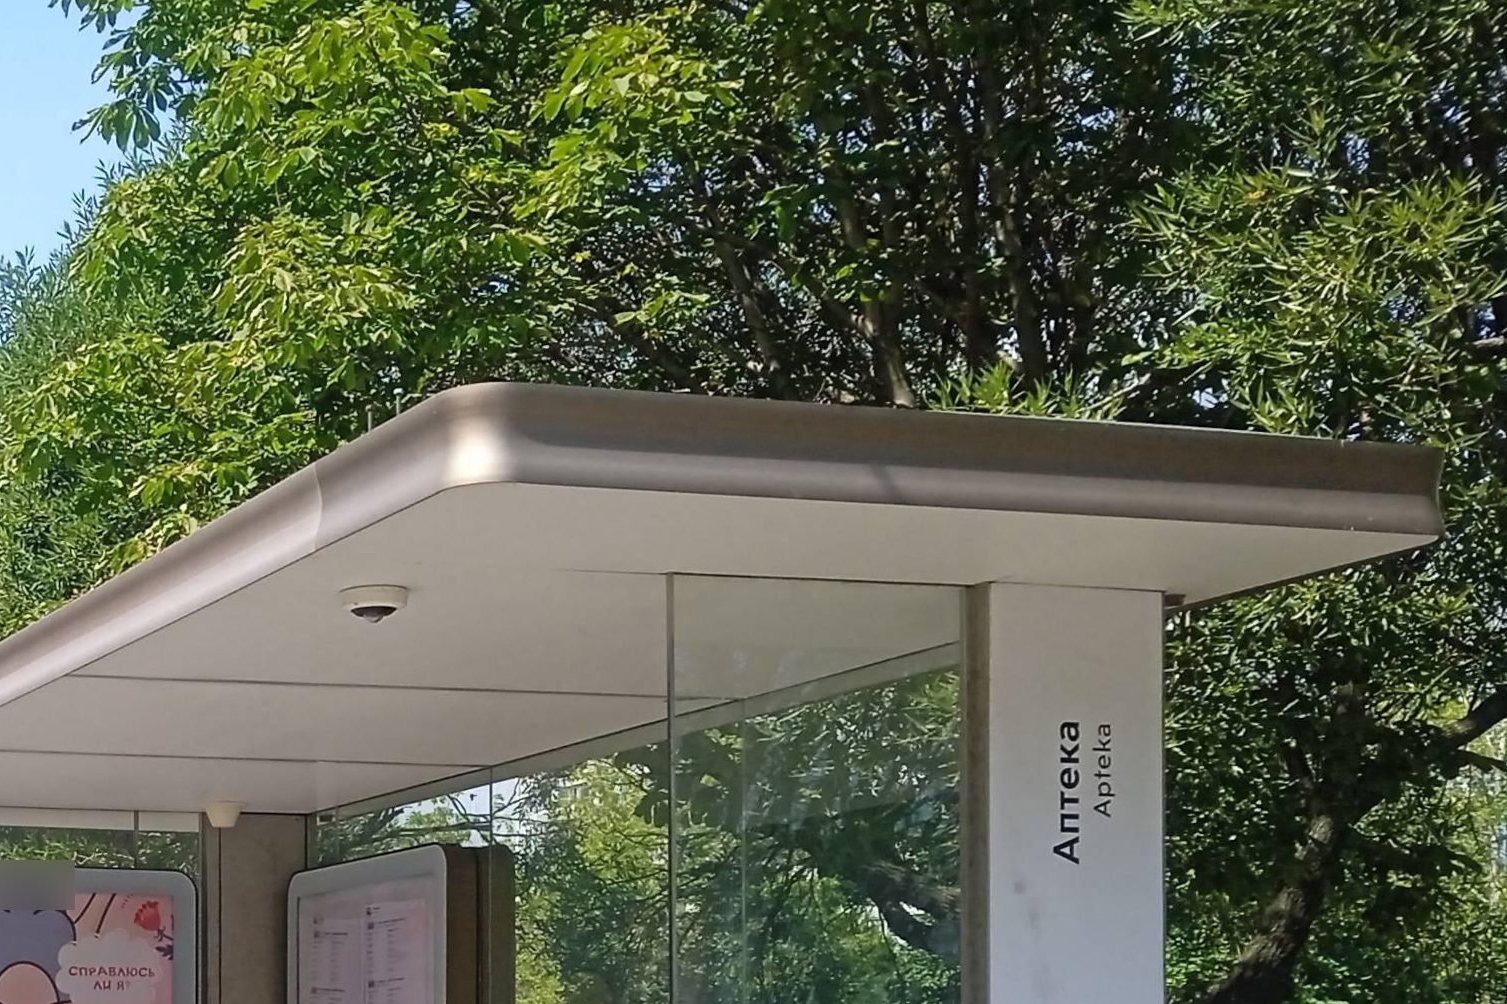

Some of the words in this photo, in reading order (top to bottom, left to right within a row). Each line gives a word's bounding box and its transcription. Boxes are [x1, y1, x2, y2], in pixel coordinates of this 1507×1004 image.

[1053, 721, 1080, 865] Аптека
[1092, 724, 1115, 818] Apteka
[68, 965, 156, 977] СПРАВЛЮСЬ
[93, 980, 111, 991] ЛИ
[116, 980, 132, 991] Я?
